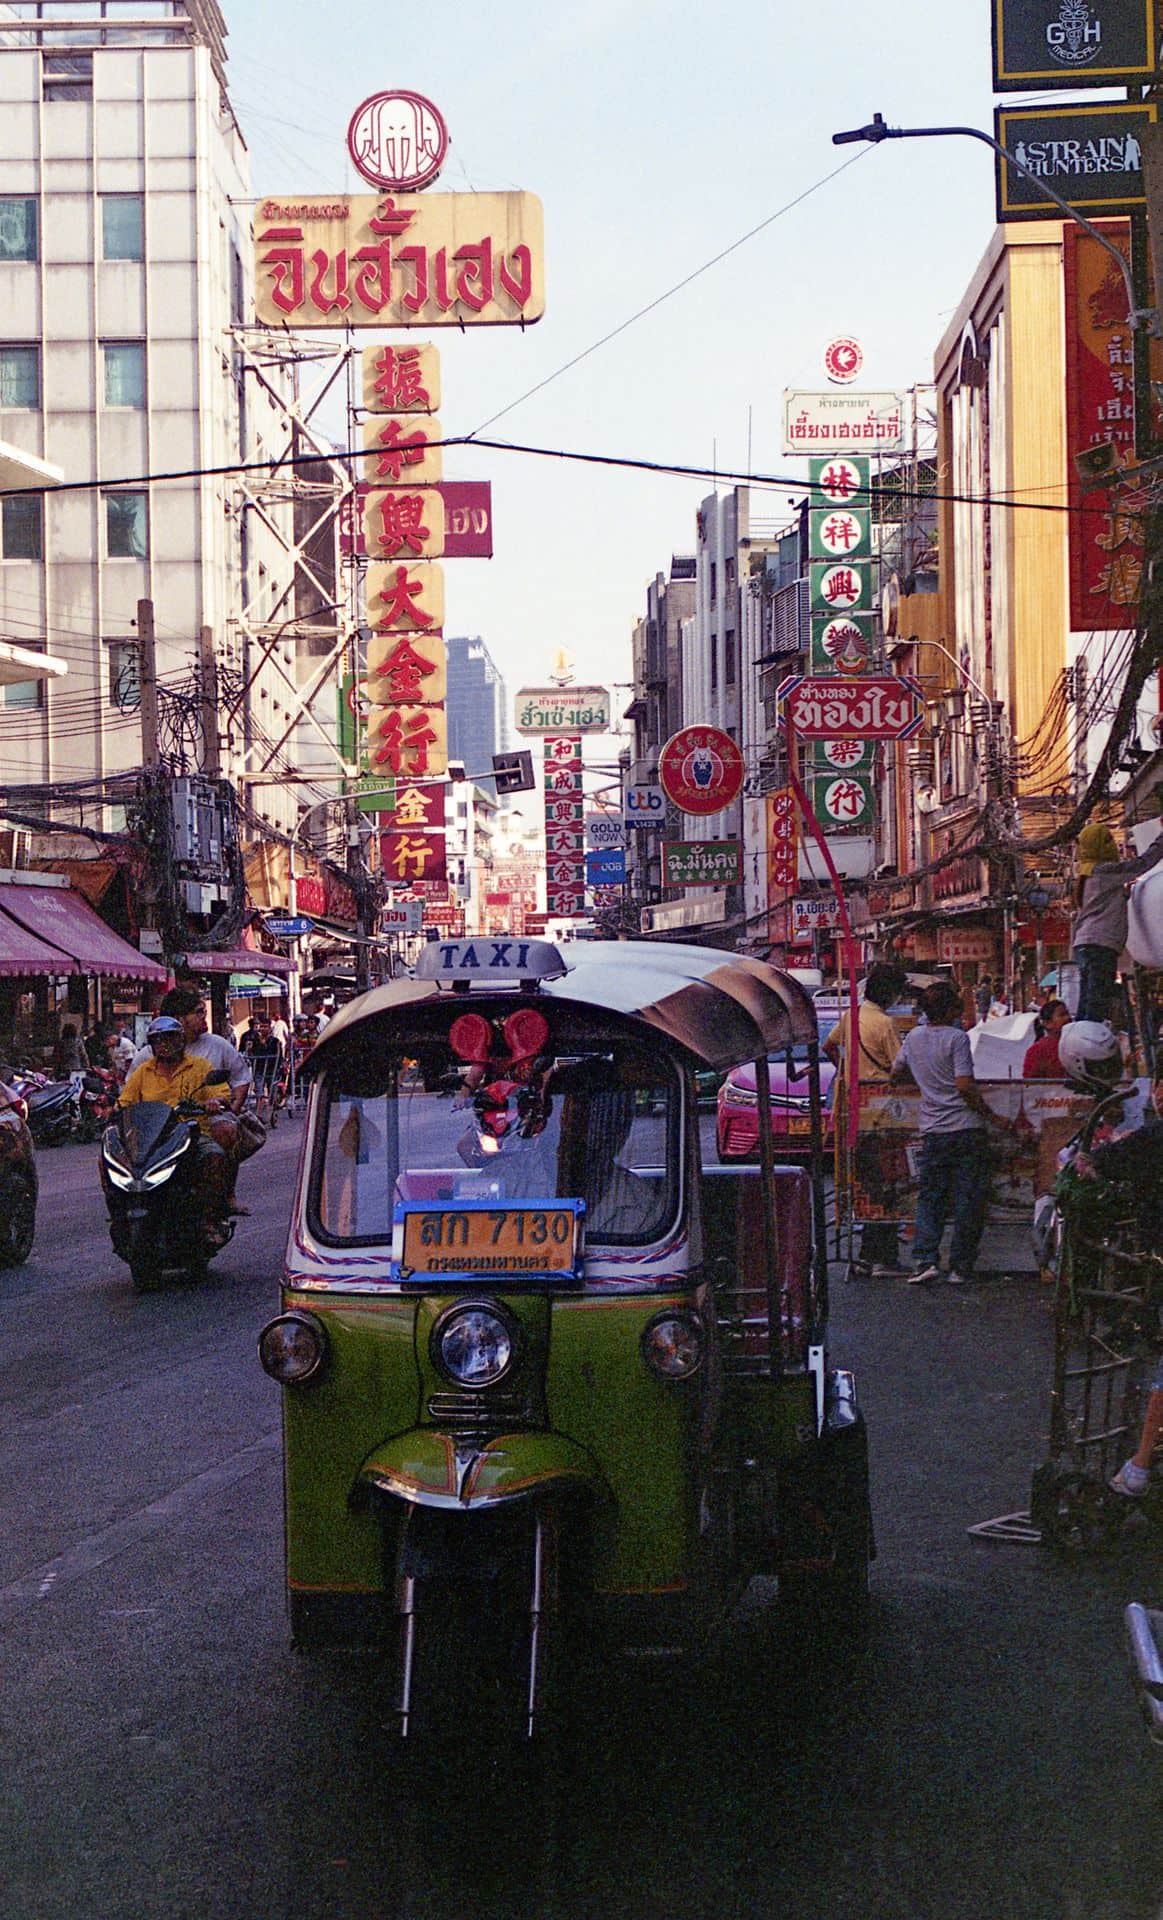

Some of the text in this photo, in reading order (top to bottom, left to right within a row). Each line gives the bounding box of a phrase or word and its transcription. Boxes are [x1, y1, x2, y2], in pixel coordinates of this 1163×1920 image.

[1051, 43, 1097, 61] MEDICAL
[1028, 137, 1125, 162] STRAIN
[1026, 155, 1125, 177] HUNTERS
[627, 791, 662, 811] ttb
[590, 823, 622, 834] GOLD
[594, 833, 619, 842] NOW
[439, 943, 531, 969] TAXI
[487, 1211, 570, 1245] 7130
